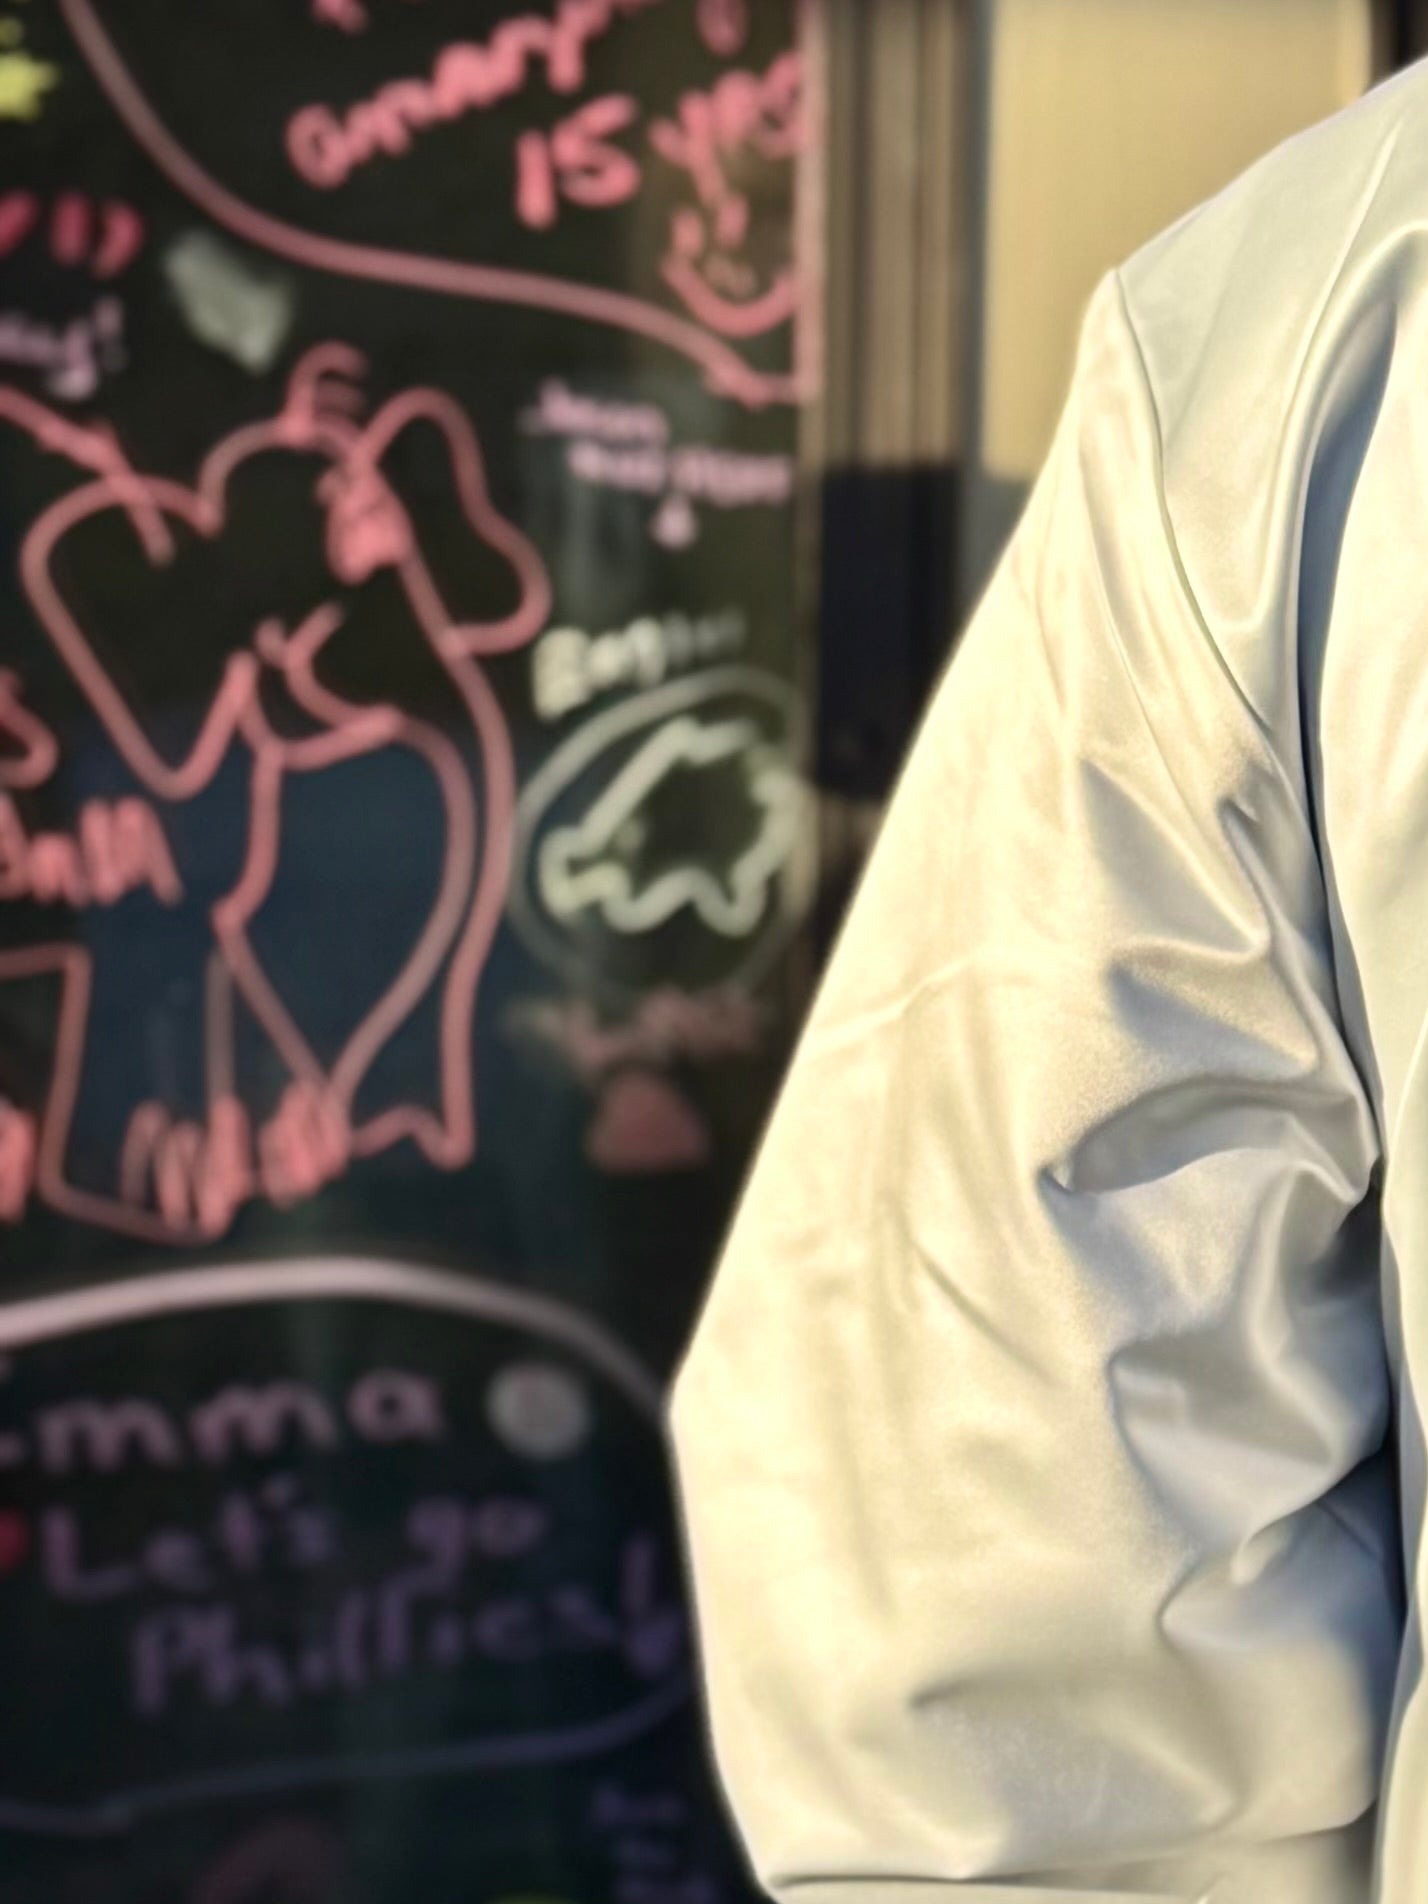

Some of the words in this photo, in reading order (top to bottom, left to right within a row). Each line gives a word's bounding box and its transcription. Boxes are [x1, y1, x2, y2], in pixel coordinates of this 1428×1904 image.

[513, 94, 643, 231] 15
[0, 1361, 450, 1474] mma
[404, 1491, 552, 1591] go
